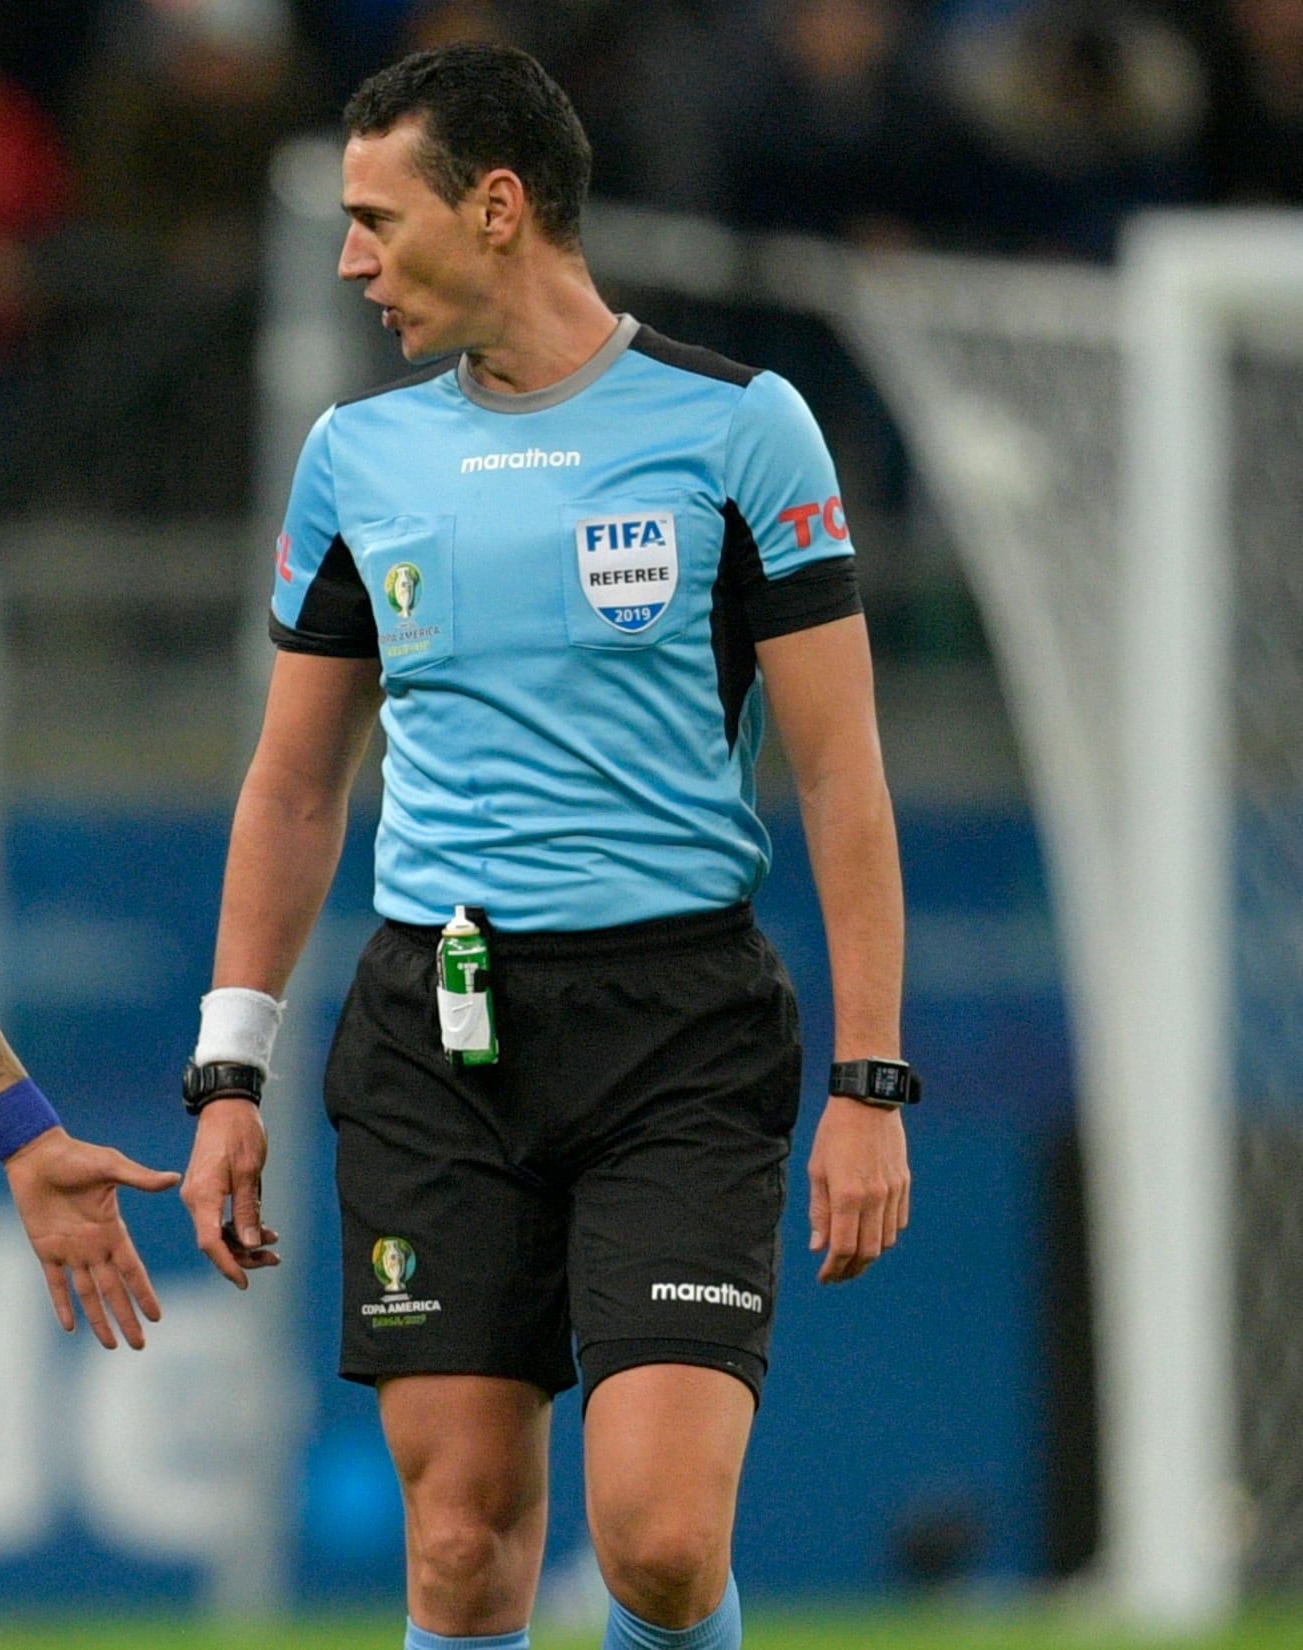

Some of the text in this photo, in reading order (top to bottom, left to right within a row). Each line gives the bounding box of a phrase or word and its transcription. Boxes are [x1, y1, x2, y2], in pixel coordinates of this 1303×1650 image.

[461, 448, 581, 473] marathon
[586, 520, 666, 552] FIFA
[590, 566, 670, 587] REFEREE
[614, 607, 652, 623] 2019
[361, 1299, 442, 1315] COPA AMERICA
[651, 1283, 763, 1313] marathon
